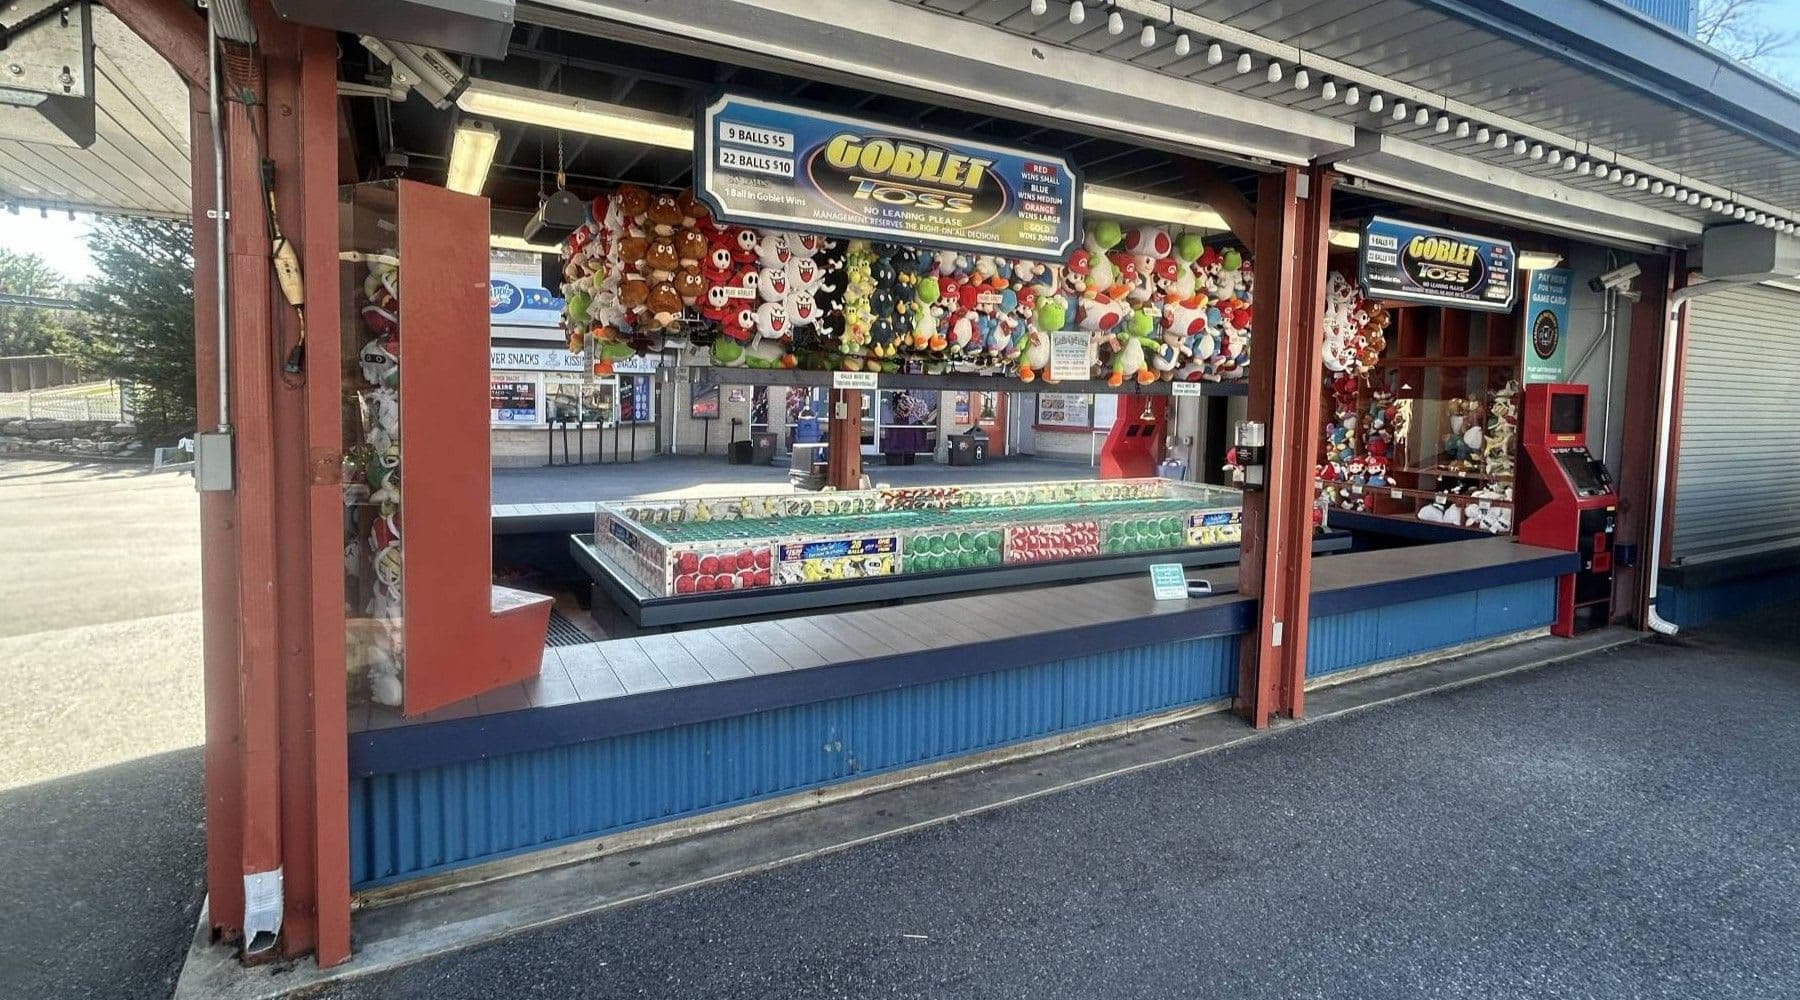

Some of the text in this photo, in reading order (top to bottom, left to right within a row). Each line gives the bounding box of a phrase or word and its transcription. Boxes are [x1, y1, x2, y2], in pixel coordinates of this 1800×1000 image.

[729, 128, 785, 147] 9 BALLS $5
[723, 152, 791, 173] 22 BALLS $10
[826, 134, 993, 189] GOBLET
[1033, 164, 1048, 174] RED
[1021, 172, 1060, 185] WINS SMALL
[849, 175, 973, 213] TOSS
[1031, 184, 1049, 194] BLUE
[725, 188, 730, 196] 1
[731, 188, 747, 198] Ball
[757, 192, 784, 203] Goblet
[786, 196, 806, 206] Wins
[1018, 191, 1063, 205] WINS MEDIUM
[1025, 203, 1055, 214] ORANGE
[864, 206, 962, 227] NO LEANING PLEASE
[1018, 211, 1061, 224] WINS LARGE
[813, 210, 1000, 241] MANAGEMENT RESERVES THE RIGHT ON ALL DECISIONS
[1030, 223, 1050, 233] GOLD
[1019, 231, 1059, 243] WINS JUMBO
[1409, 235, 1479, 266] GOBLET
[1418, 262, 1470, 283] TOSS
[1538, 273, 1549, 281] PAY
[1430, 282, 1449, 290] LEANING
[1538, 283, 1549, 292] FOR
[1532, 293, 1567, 305] GAME CARD
[508, 353, 539, 365] SNACKS
